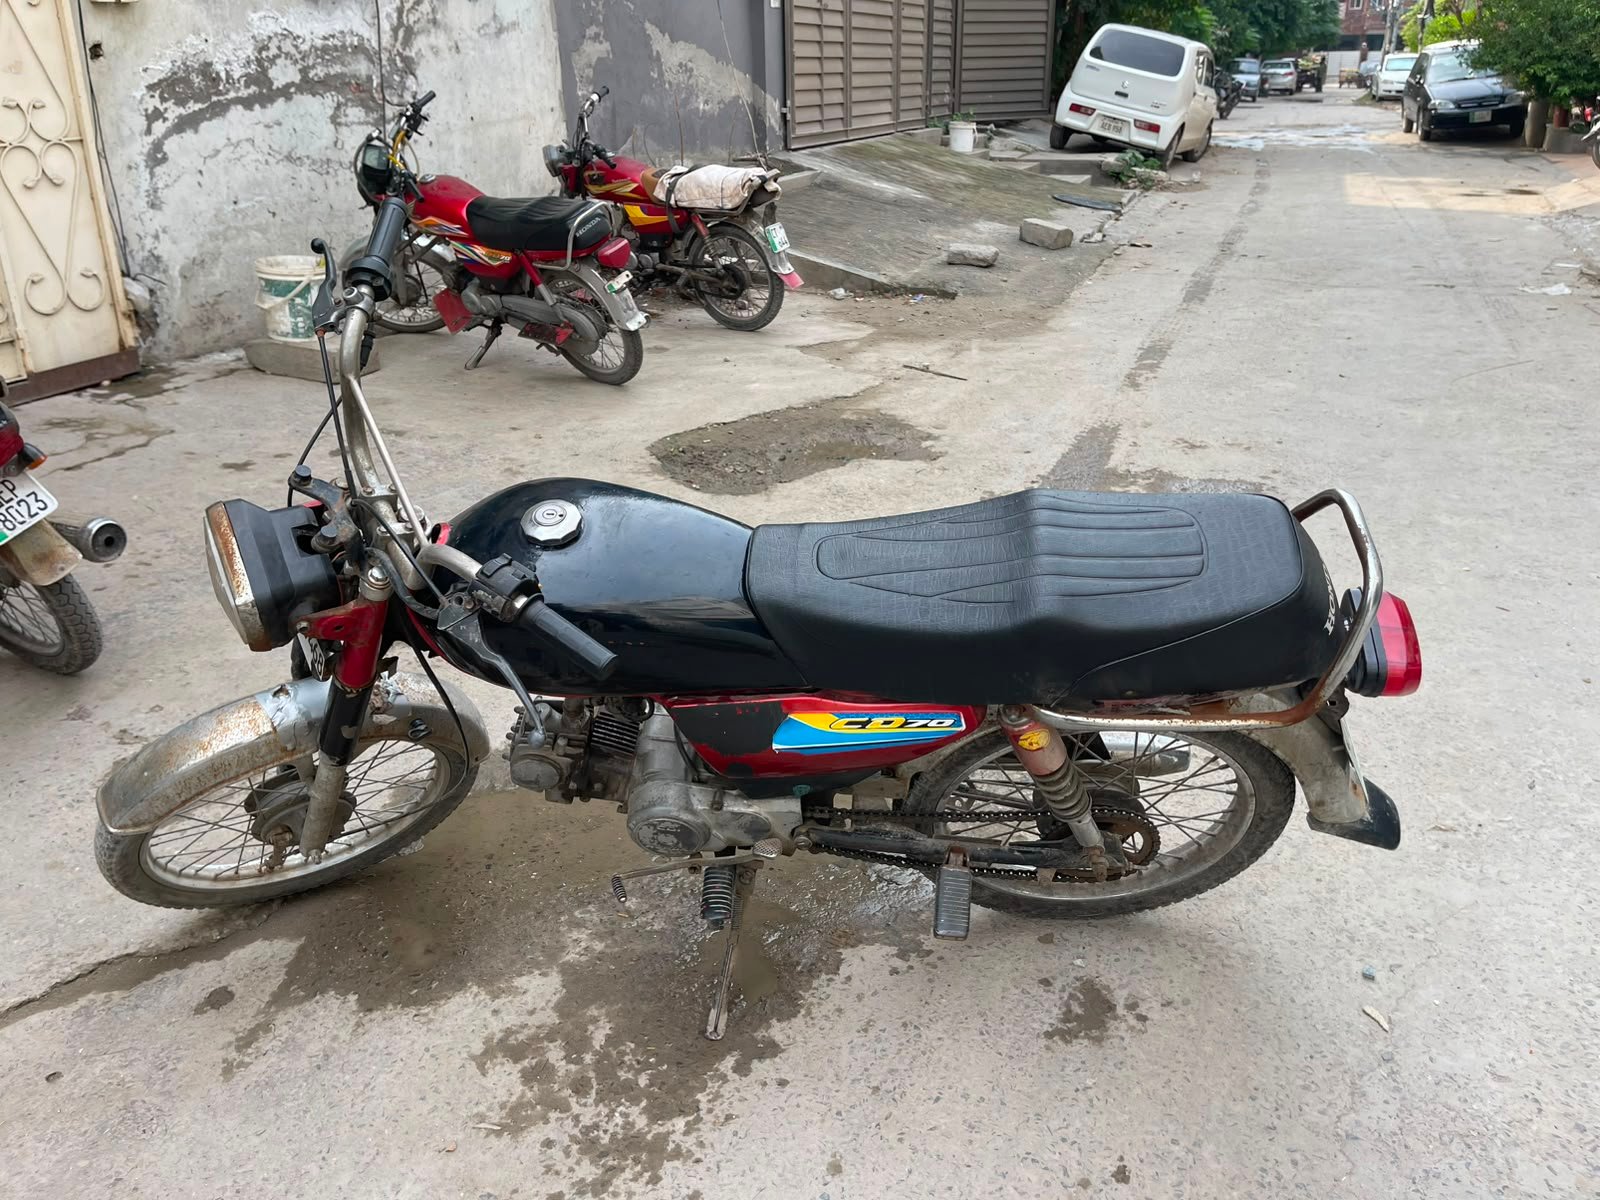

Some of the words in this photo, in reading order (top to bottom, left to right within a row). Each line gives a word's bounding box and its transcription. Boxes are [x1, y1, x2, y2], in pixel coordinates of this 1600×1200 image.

[575, 216, 602, 237] HONDA
[0, 479, 18, 509] EP
[0, 491, 48, 531] 8023
[830, 717, 956, 730] CD70
